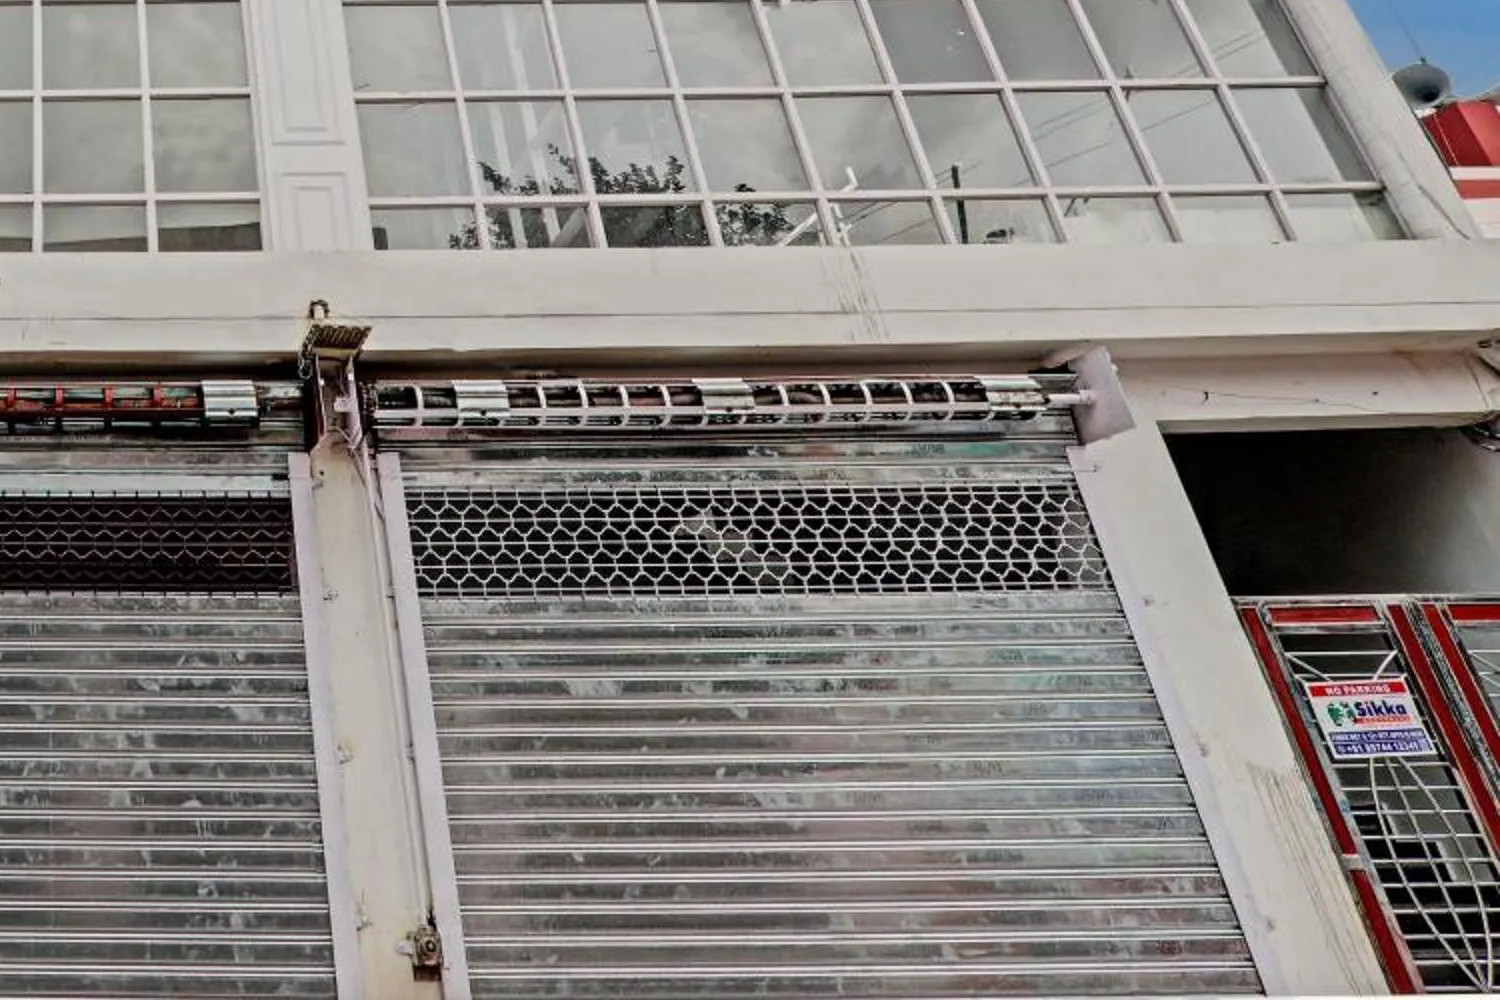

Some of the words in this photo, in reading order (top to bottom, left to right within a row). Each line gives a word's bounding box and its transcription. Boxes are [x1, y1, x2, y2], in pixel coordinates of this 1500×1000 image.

[1325, 686, 1340, 696] NO
[1343, 684, 1391, 695] PARKING
[1353, 700, 1408, 717] Sikka
